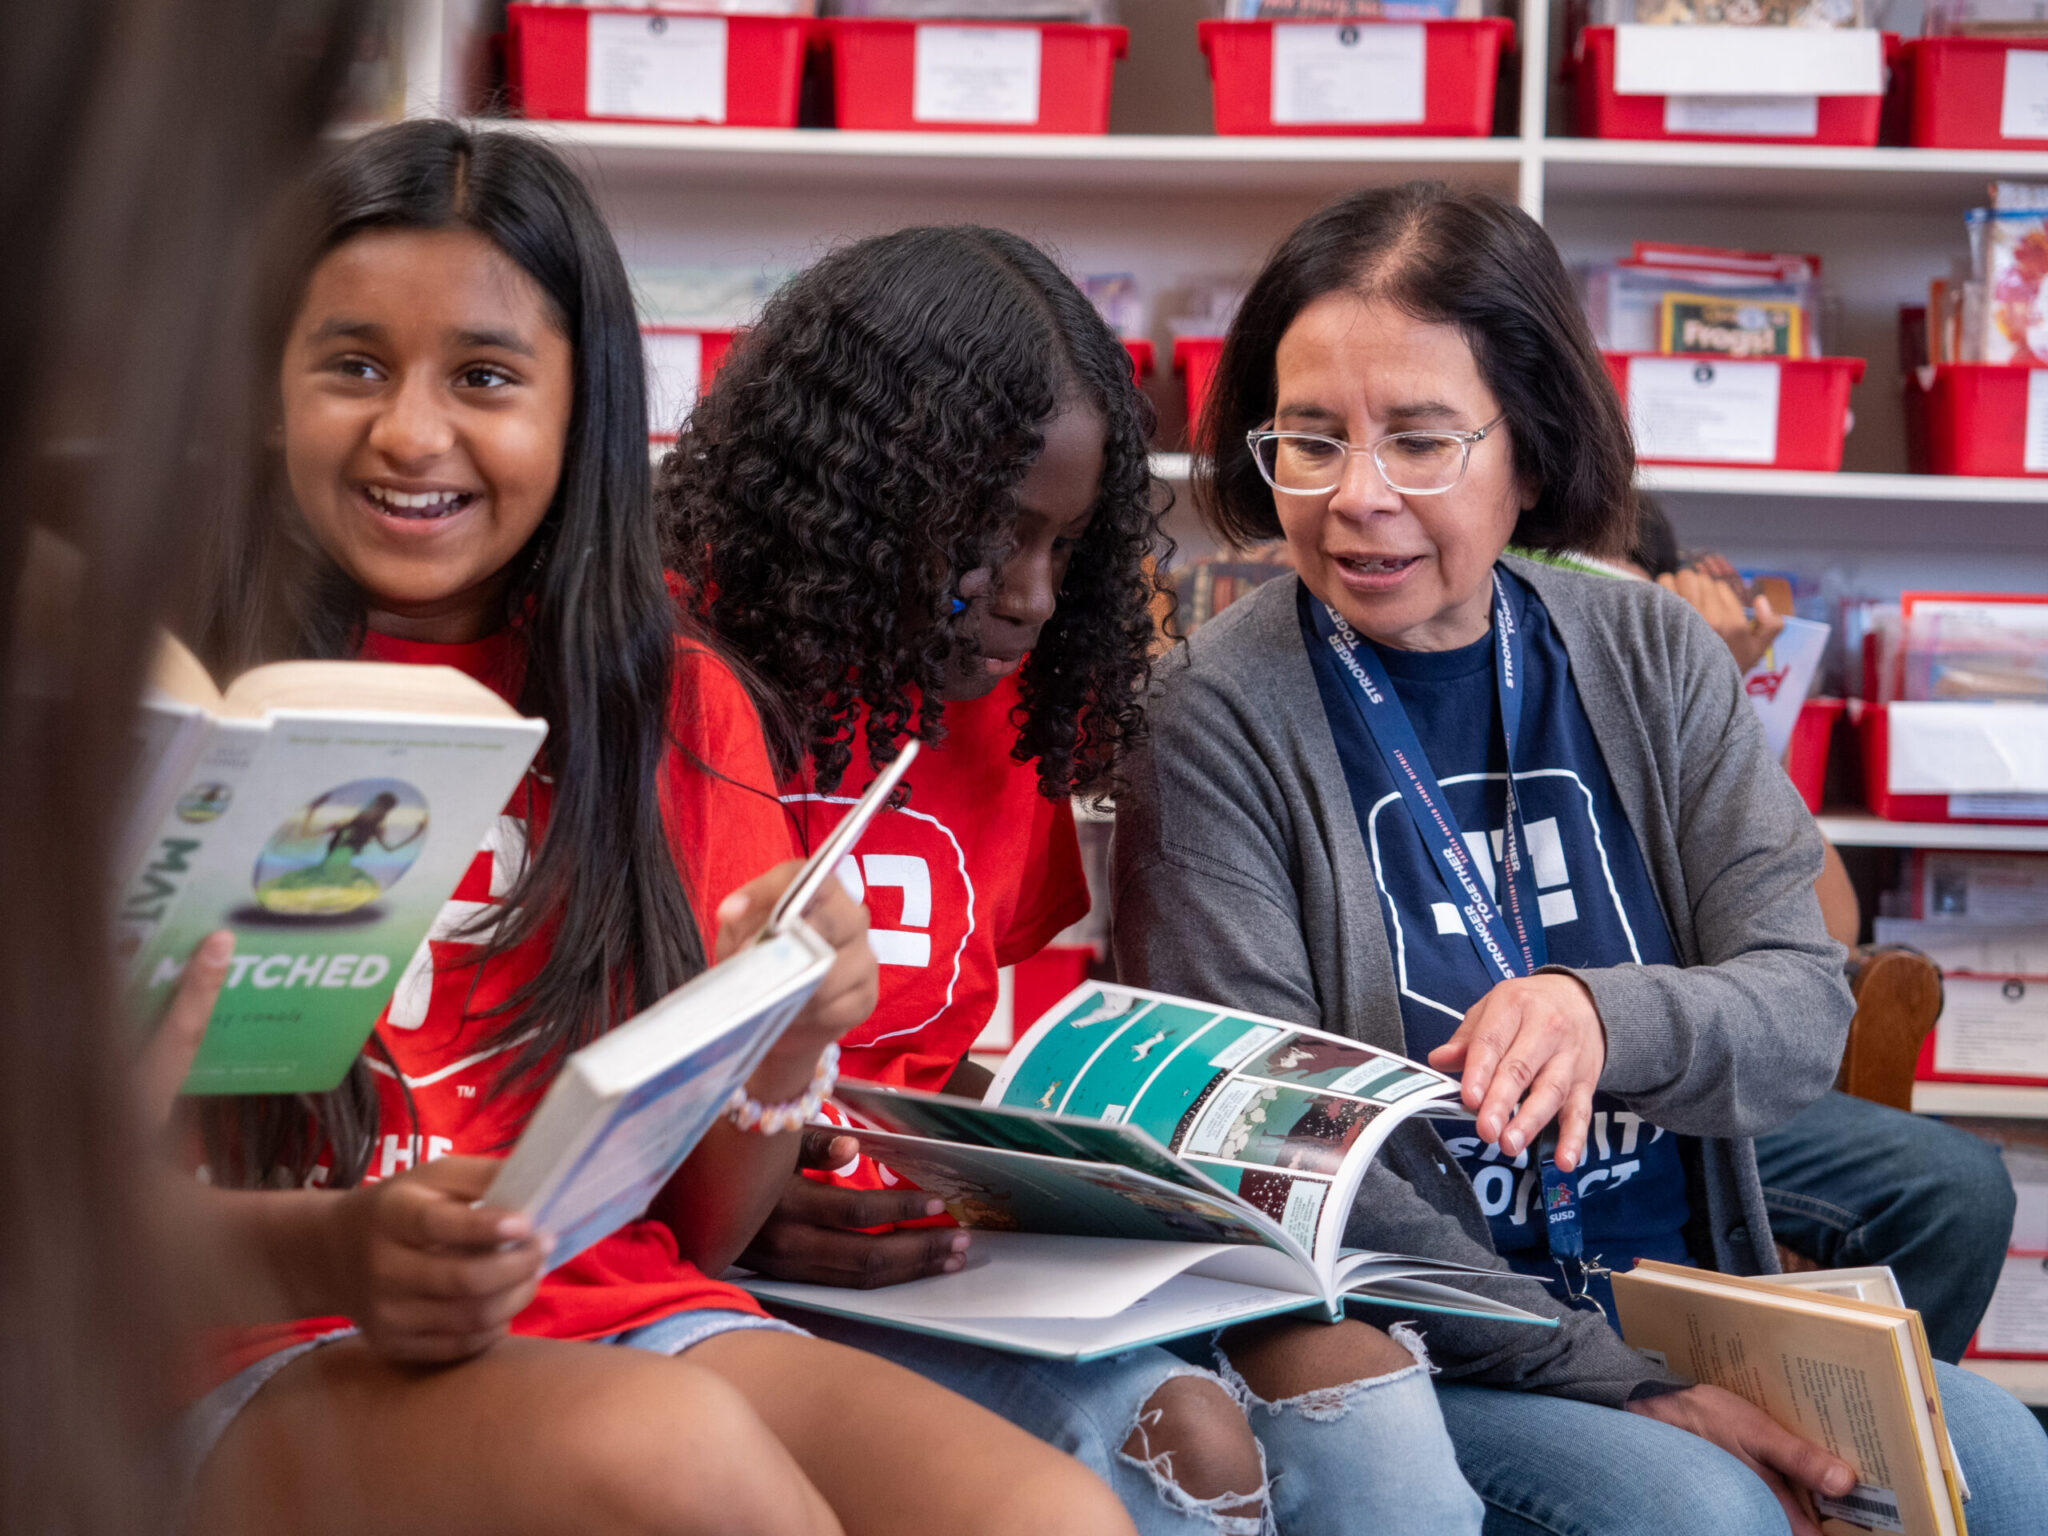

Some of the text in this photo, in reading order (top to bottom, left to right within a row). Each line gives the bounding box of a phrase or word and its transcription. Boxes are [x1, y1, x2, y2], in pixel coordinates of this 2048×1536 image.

[1324, 603, 1361, 651] TOGET
[1497, 608, 1514, 690] STRONGER
[1327, 633, 1384, 705] STRONGER
[1393, 749, 1417, 781] DISTRICT
[1414, 781, 1434, 808] SCHOOL
[1443, 848, 1494, 923] TOGETHER
[1464, 905, 1516, 979] STRONGER
[148, 953, 390, 990] MTCHED
[375, 1134, 453, 1177] HE
[1549, 1210, 1576, 1224] SUSD
